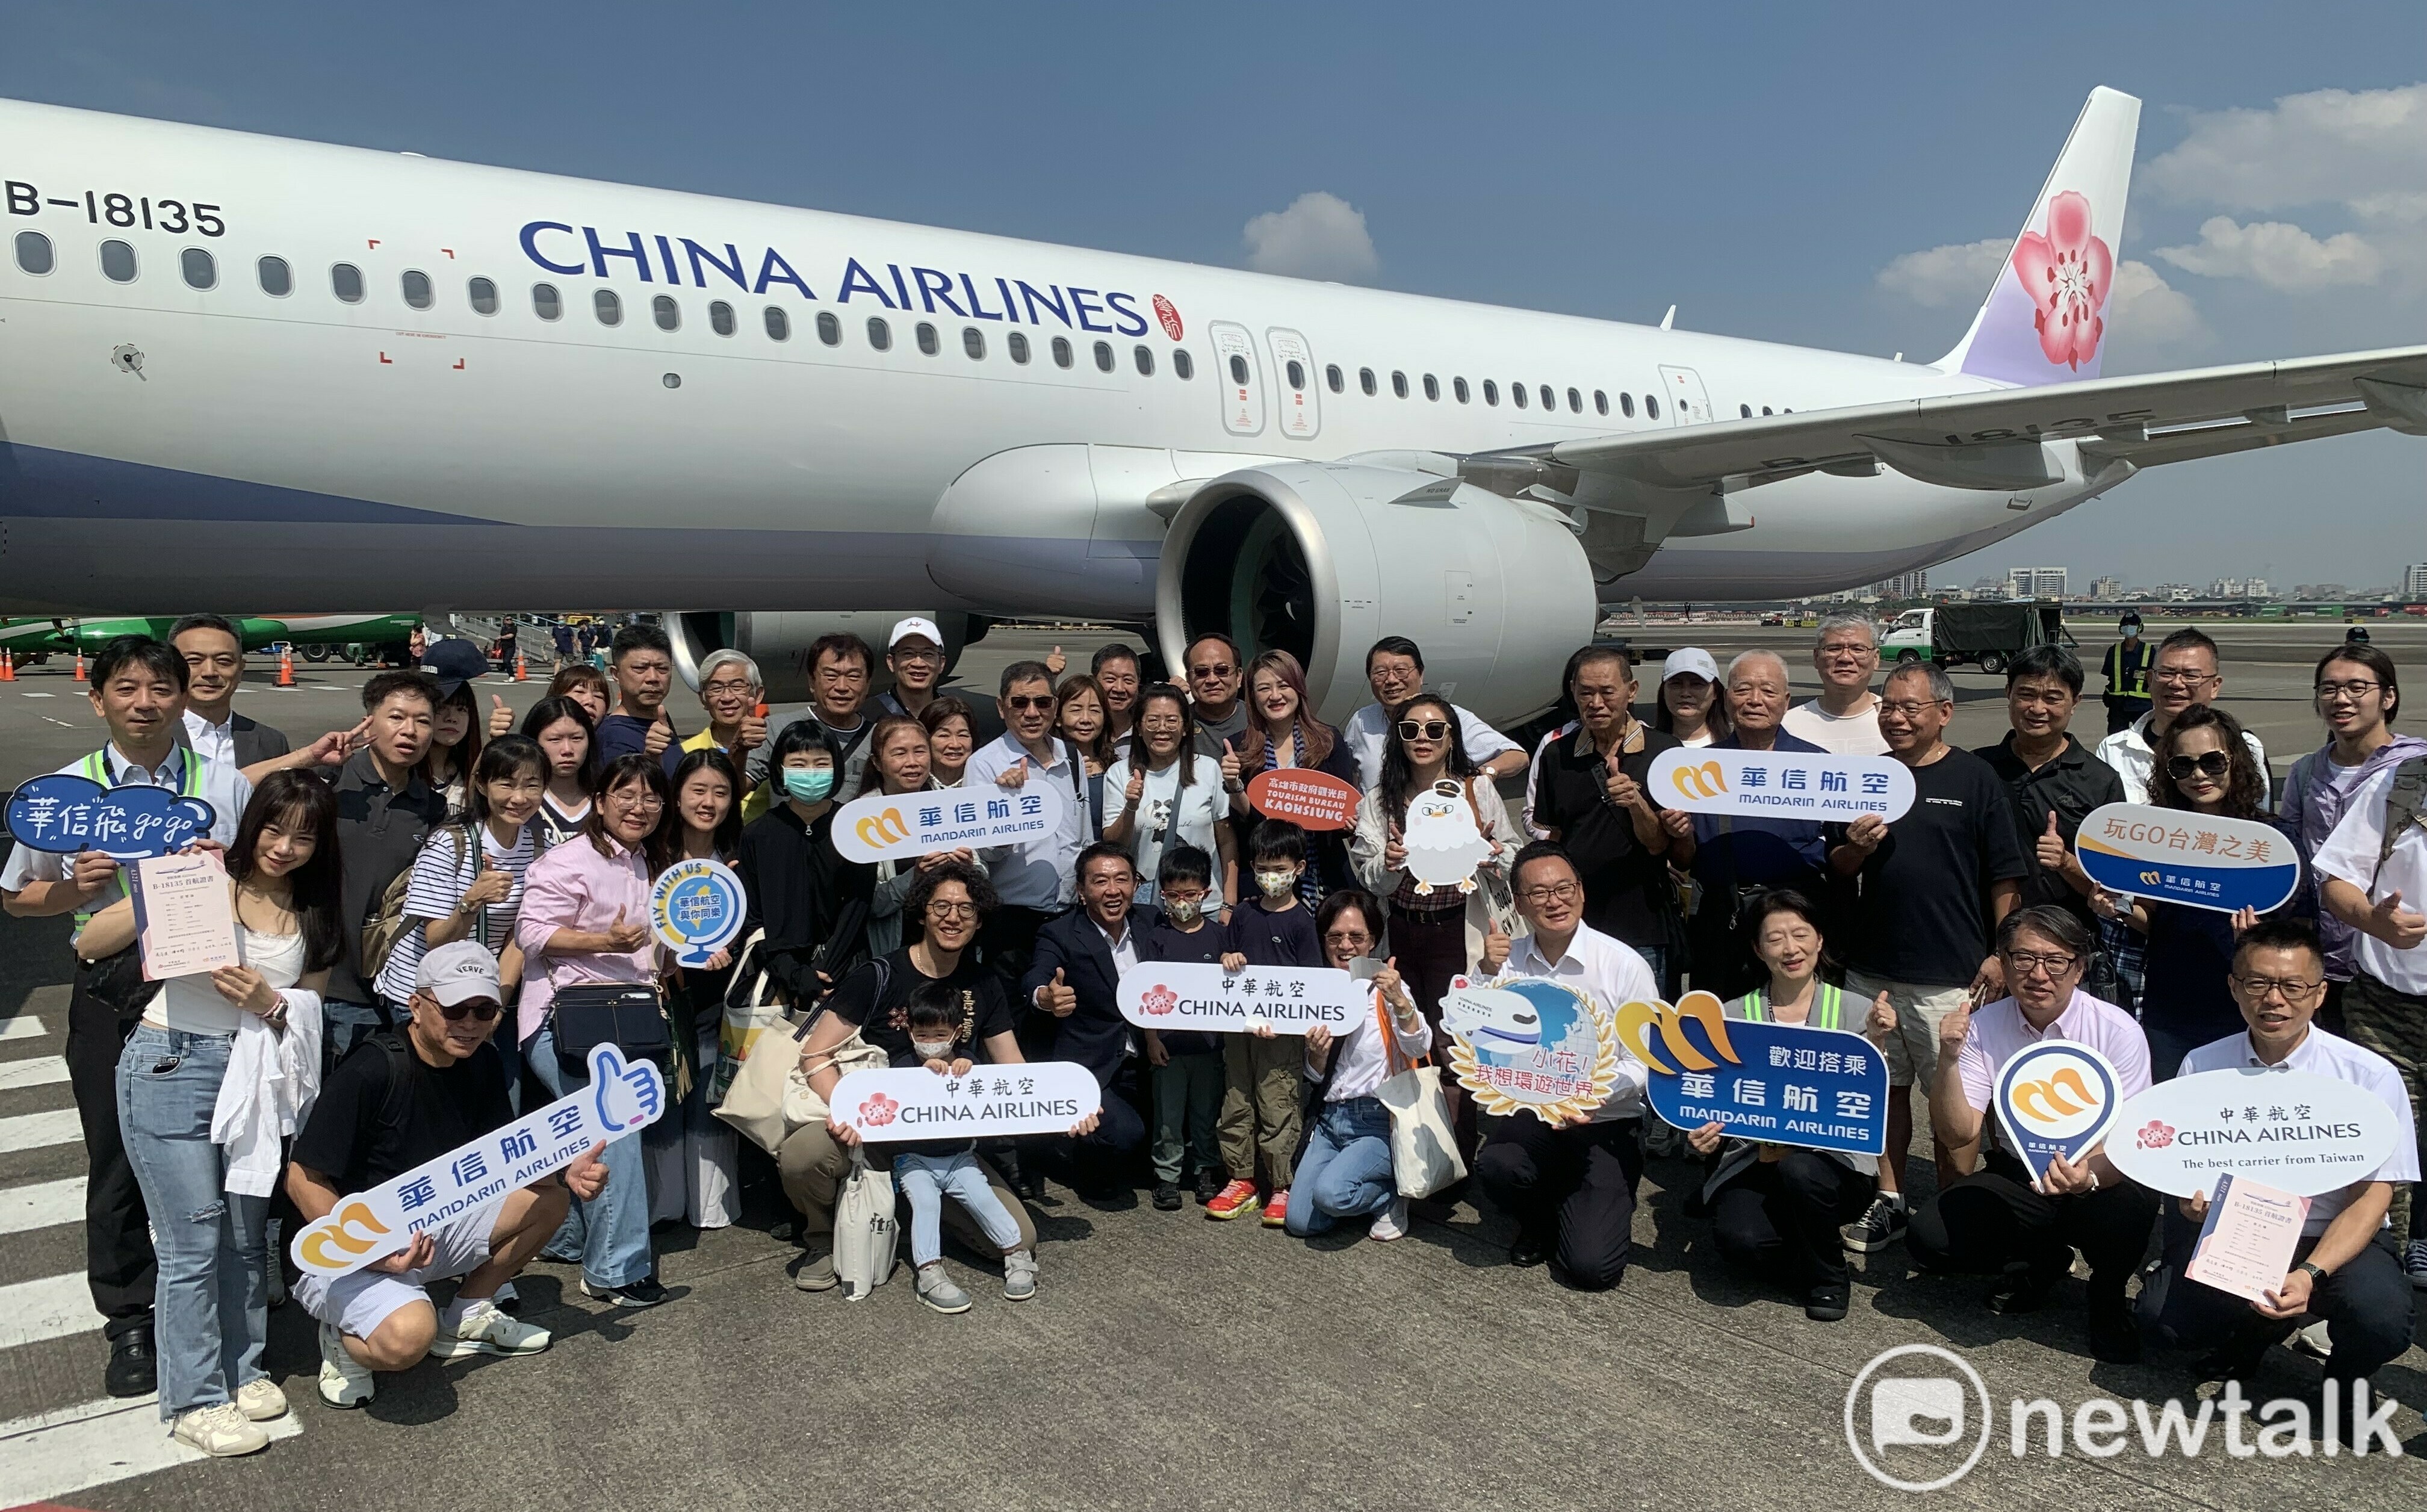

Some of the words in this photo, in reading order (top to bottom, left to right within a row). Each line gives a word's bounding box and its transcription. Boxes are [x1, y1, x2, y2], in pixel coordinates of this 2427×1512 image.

[5, 181, 226, 237] B-18135
[519, 221, 818, 300] CHINA
[837, 257, 1149, 337] AIRLINES
[1268, 777, 1347, 800] 高雄市政府觀光局
[1740, 766, 1888, 795] 華信航空
[919, 795, 1043, 827] 華信航空
[1265, 798, 1343, 822] KAOHSIUNG
[1267, 790, 1306, 802] TOURISM
[1309, 797, 1345, 809] BUREAU
[1739, 794, 1815, 808] MANDARIN
[1821, 798, 1888, 812] AIRLINES
[26, 797, 127, 842] 華信飛
[921, 827, 986, 843] MANDARIN
[991, 820, 1044, 835] AIRLINES
[2103, 817, 2271, 863] 玩GO台灣之美
[685, 863, 702, 875] US
[153, 881, 183, 890] B-18135
[185, 876, 214, 885] 首航證書
[654, 869, 683, 900] WITH
[2164, 884, 2193, 893] MANDARIN
[2165, 875, 2221, 891] 華信航空
[680, 895, 721, 907] 華信航空
[652, 906, 668, 929] FLY
[680, 908, 721, 920] 與你同樂
[455, 967, 485, 975] VERVE
[1221, 977, 1306, 997] 中華航空
[1178, 999, 1246, 1017] CHINA
[1252, 1002, 1345, 1021] AIRLINES
[1768, 1046, 1867, 1076] 歡迎搭乘
[946, 1077, 1035, 1098] 中華航空
[1475, 1065, 1595, 1100] 我想環遊世界
[1681, 1071, 1871, 1119] 華信航空
[900, 1105, 975, 1124] CHINA
[981, 1099, 1078, 1120] AIRLINES
[2219, 1103, 2312, 1124] 中華航空
[1679, 1106, 1776, 1129] MANDARIN
[1785, 1119, 1870, 1141] AIRLINES
[2177, 1129, 2251, 1146] CHINA
[2258, 1123, 2361, 1142] AIRLINES
[397, 1105, 584, 1213] 華信航空
[2181, 1157, 2204, 1169] The
[2208, 1156, 2234, 1168] best
[2237, 1154, 2280, 1167] carrier
[2284, 1153, 2316, 1166] from
[2319, 1152, 2364, 1163] Taiwan
[407, 1177, 507, 1236] MANDARIN
[515, 1136, 590, 1184] AIRLINES
[2234, 1201, 2263, 1215] B-18135
